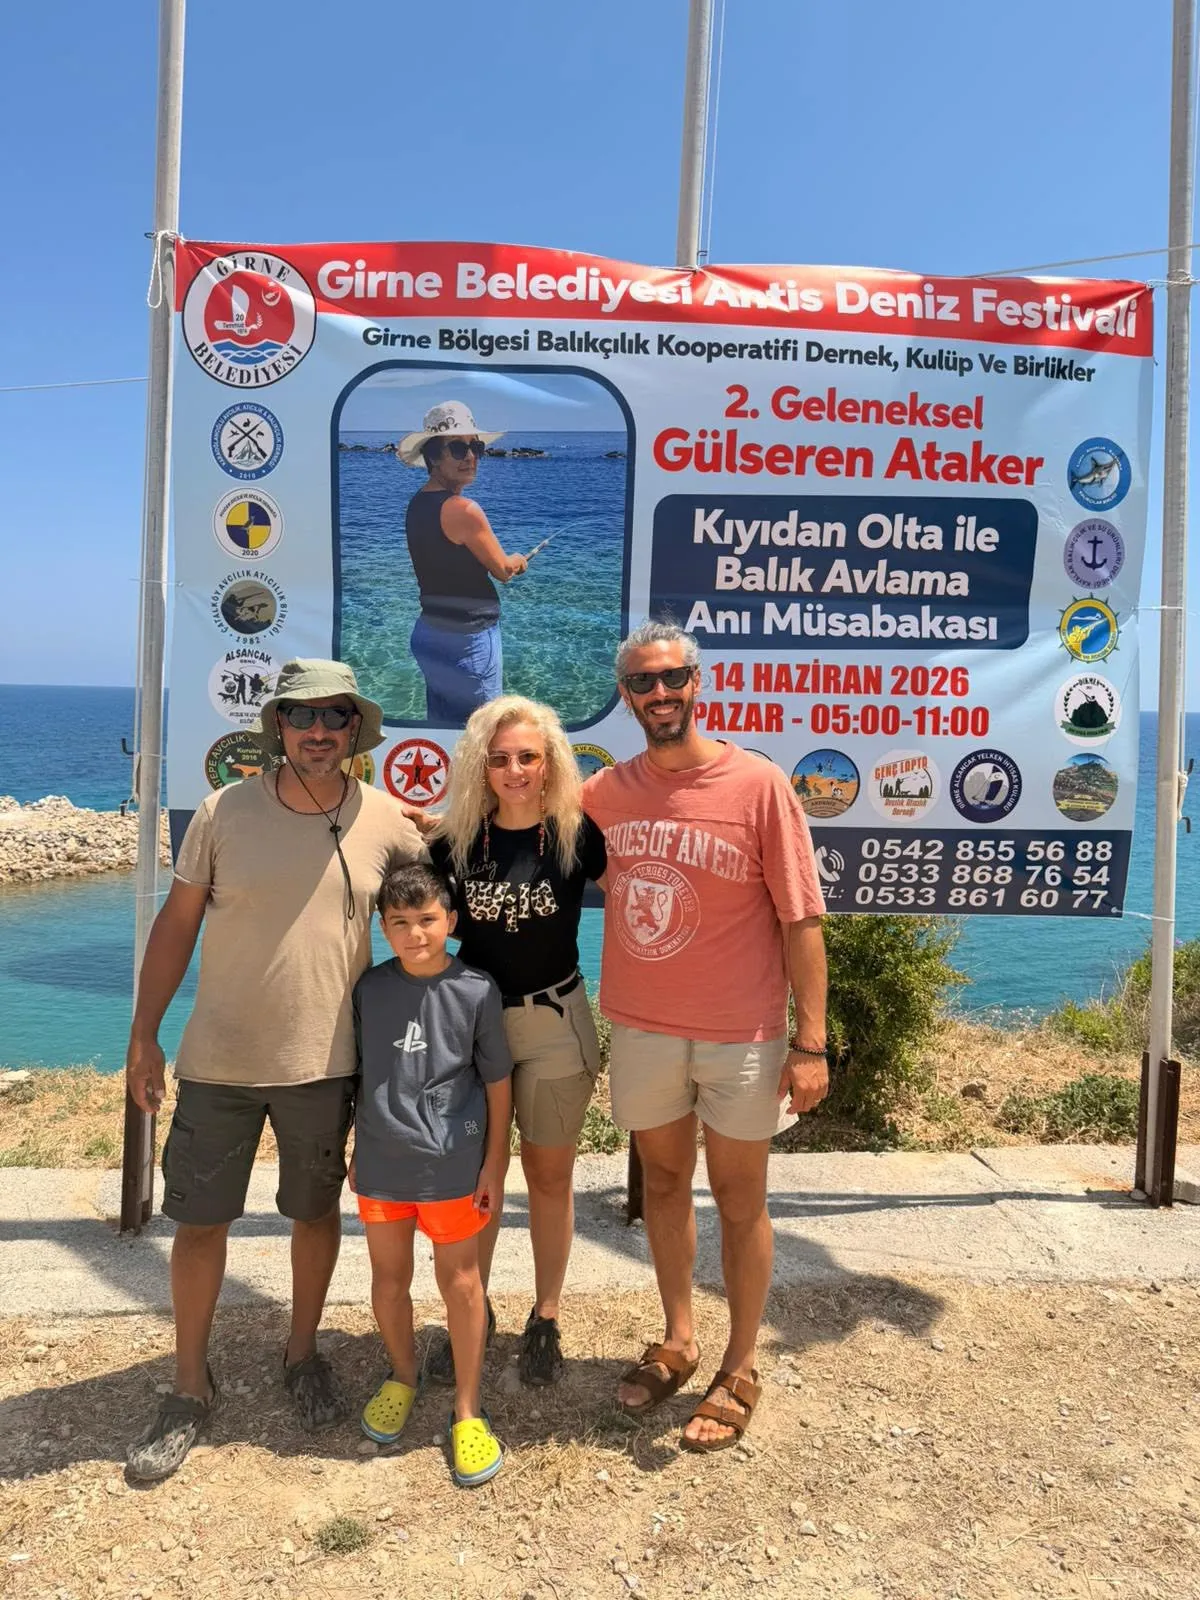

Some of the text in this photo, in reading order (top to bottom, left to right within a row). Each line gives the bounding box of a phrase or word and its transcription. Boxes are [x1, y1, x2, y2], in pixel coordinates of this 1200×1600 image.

[216, 255, 291, 282] GİRNE
[235, 313, 245, 321] 20
[316, 259, 1138, 339] Girne Belediyesi Antis Deniz Festivali
[193, 342, 303, 385] BELEDİYESİ
[362, 327, 1097, 384] Girne Bölgesi Balıkçılık Kooperatifi Dernek, Kulüp Ve Birlikler
[724, 383, 985, 431] 2. Geleneksel
[652, 427, 874, 479] Gülseren
[883, 436, 1045, 487] Ataker
[693, 508, 1000, 555] Kıyıdan Olta ile
[715, 555, 970, 598] Balık Avlama
[684, 600, 999, 641] Anı Müsabakası
[225, 648, 272, 666] ALSANCAK
[710, 658, 970, 697] 14 HAZİRAN 2026
[694, 701, 785, 733] PAZAR
[810, 703, 990, 738] 05:00-11:00
[976, 752, 1004, 762] YELKEN
[649, 819, 679, 859] OF
[676, 826, 713, 870] AN
[860, 837, 1113, 862] 0542 855 56 88
[820, 886, 845, 898] EL:
[858, 863, 1111, 887] 0533 868 76 54
[855, 885, 1109, 910] 0533 861 60 77
